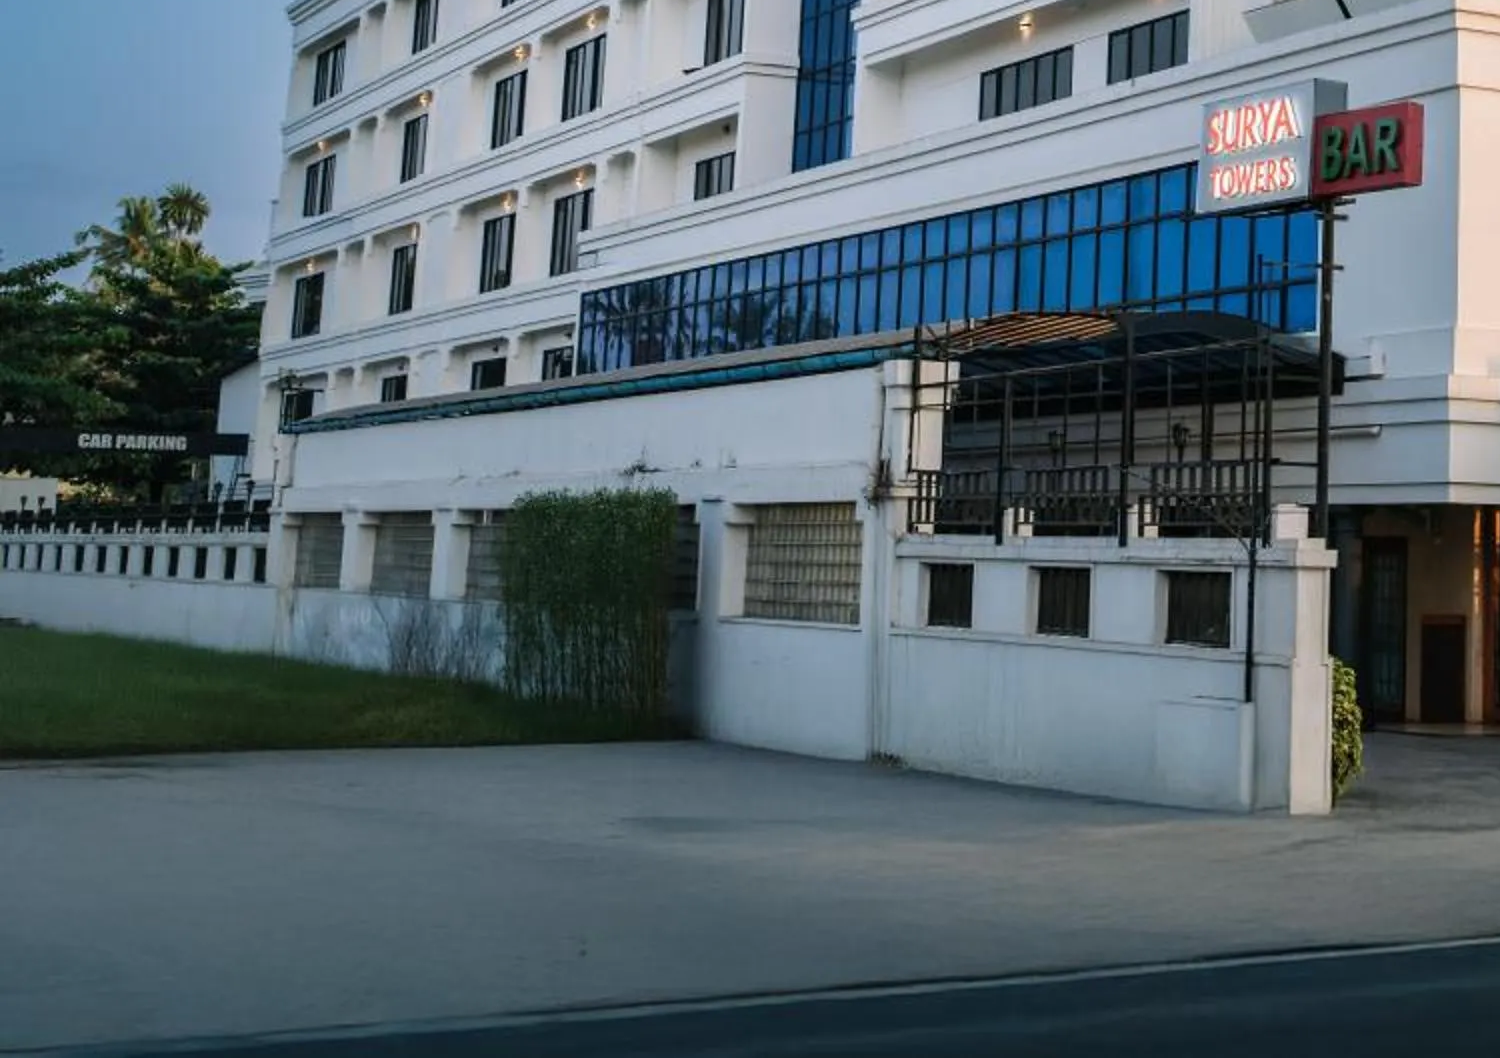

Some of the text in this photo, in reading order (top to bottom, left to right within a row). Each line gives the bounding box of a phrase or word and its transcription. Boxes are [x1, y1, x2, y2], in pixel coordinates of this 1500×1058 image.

[1206, 95, 1300, 155] SURYA
[1320, 116, 1399, 182] BAR
[1210, 157, 1297, 199] TOWERS
[78, 433, 187, 451] CAR PARKING
